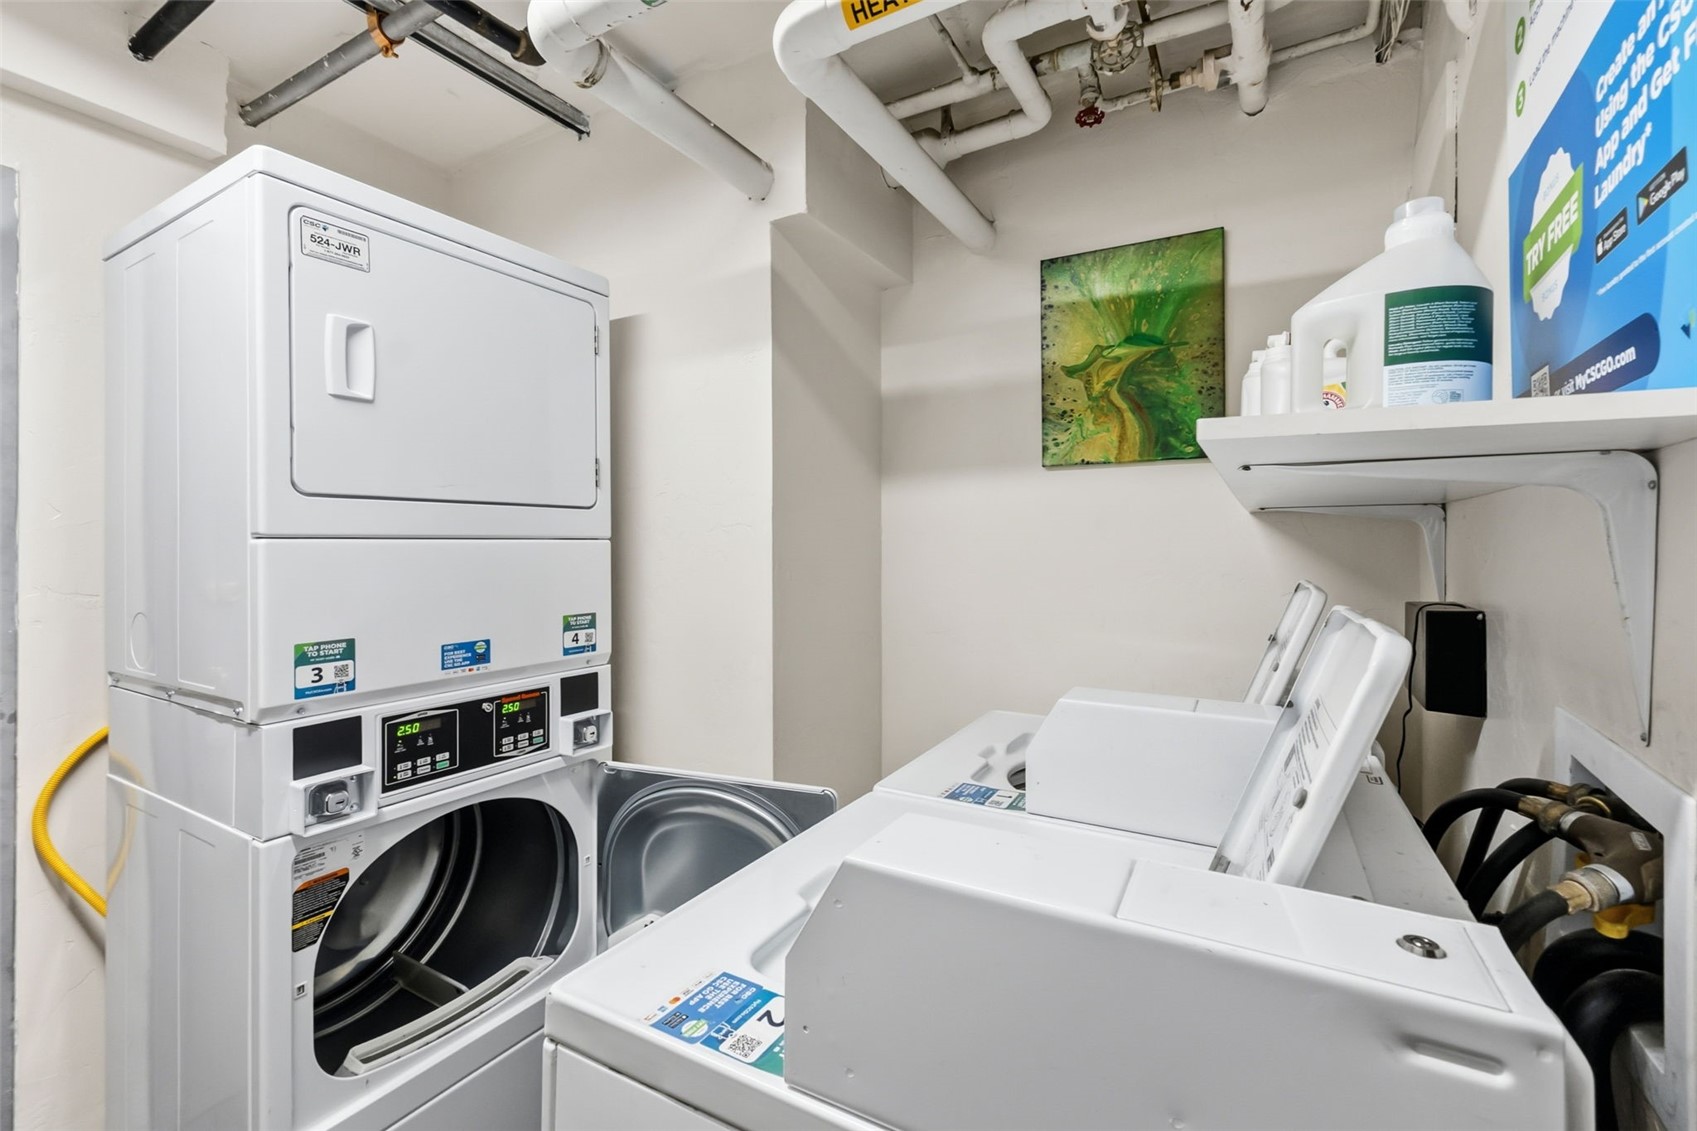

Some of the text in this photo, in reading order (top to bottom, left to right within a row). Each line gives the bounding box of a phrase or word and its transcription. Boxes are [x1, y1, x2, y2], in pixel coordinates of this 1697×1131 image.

[851, 0, 908, 24] HEA
[1596, 0, 1656, 103] Create an
[1595, 78, 1629, 138] Using
[1630, 42, 1655, 89] the
[1594, 130, 1619, 175] App
[1621, 84, 1648, 140] and
[1651, 46, 1680, 100] Get
[303, 219, 321, 229] CSC
[1526, 190, 1579, 276] TRY FREE
[310, 233, 361, 257] 524-JWR
[1575, 346, 1637, 391] MyCSCGO.com
[320, 642, 347, 651] PHONE
[571, 632, 580, 645] 4
[319, 647, 344, 657] START
[311, 666, 324, 684] 3
[502, 702, 520, 714] 2.50
[397, 722, 420, 737] 2.50
[696, 980, 742, 1014] EXPERIENCE
[756, 1009, 785, 1028] 2
